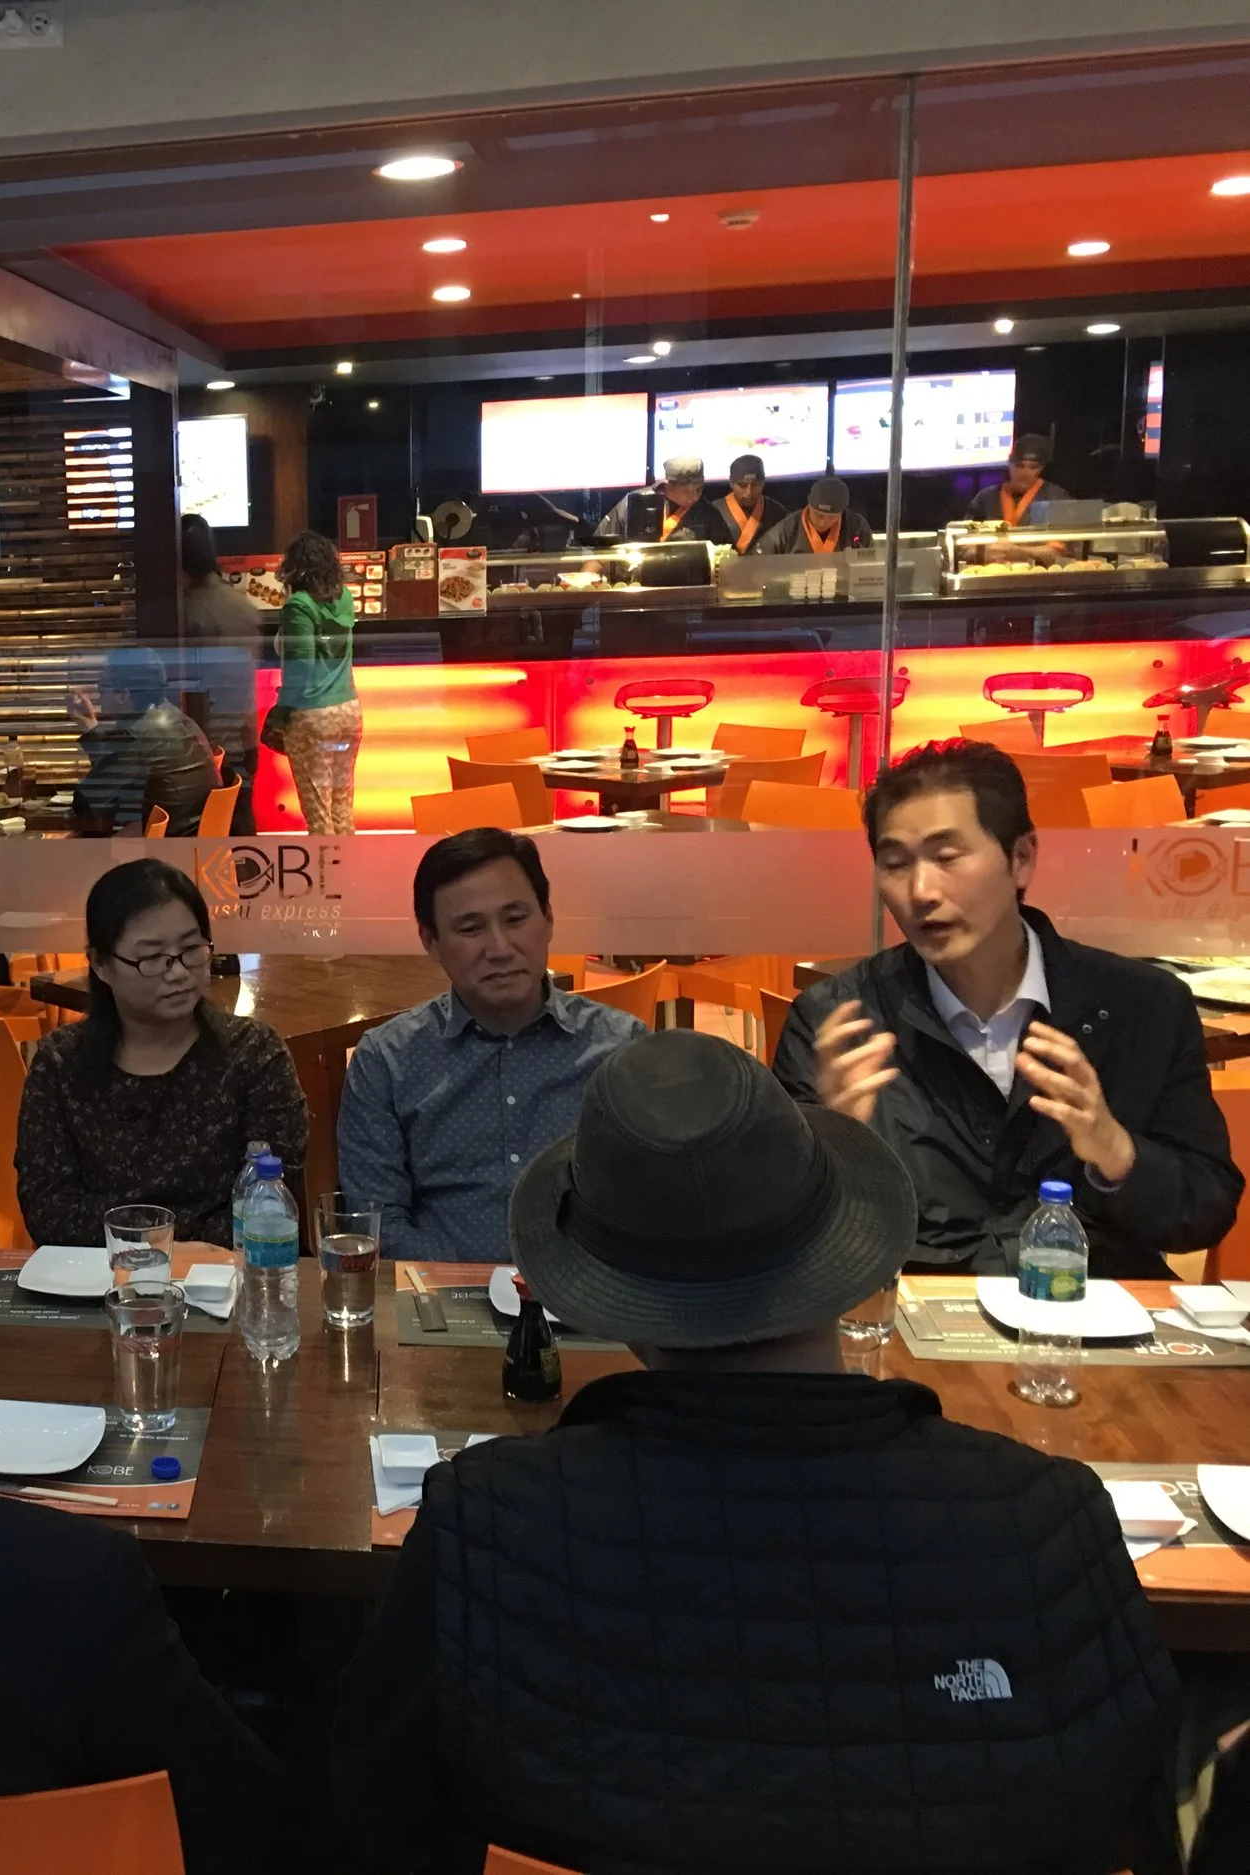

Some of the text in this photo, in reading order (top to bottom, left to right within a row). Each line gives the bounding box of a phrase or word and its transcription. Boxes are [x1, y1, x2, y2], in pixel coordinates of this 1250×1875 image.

[195, 845, 342, 900] KOBE
[261, 904, 342, 922] express
[86, 1464, 135, 1476] KOBE
[956, 1660, 984, 1674] THE
[934, 1671, 984, 1690] NORTH
[951, 1686, 986, 1702] FACE
